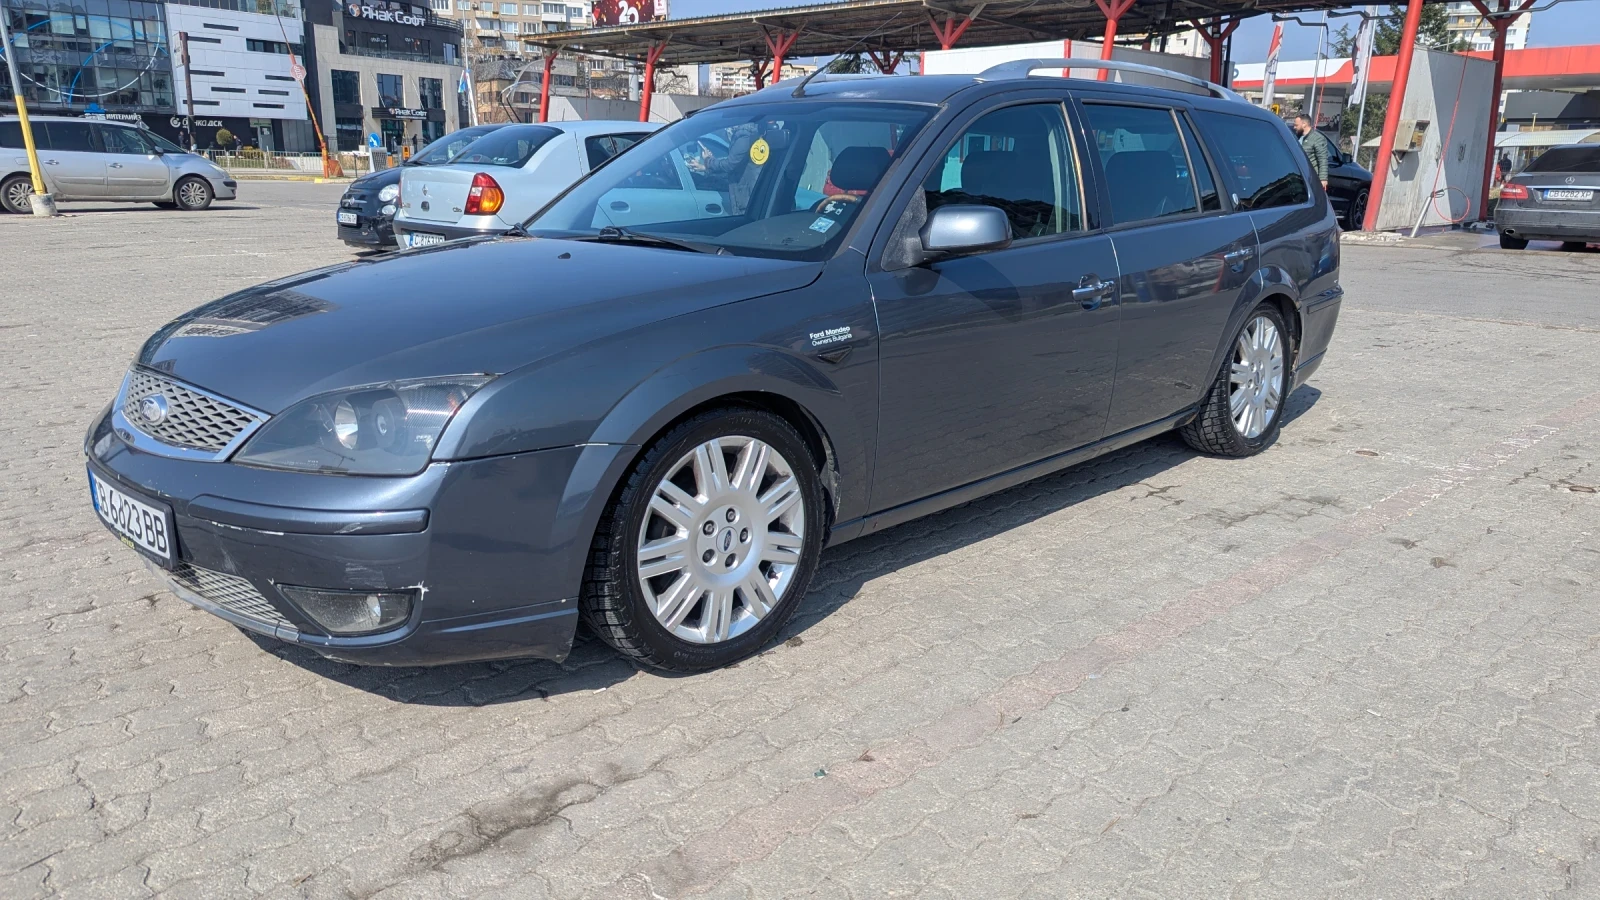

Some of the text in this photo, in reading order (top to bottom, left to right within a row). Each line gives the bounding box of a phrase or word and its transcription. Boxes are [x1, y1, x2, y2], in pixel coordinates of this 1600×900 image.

[361, 6, 426, 27] Янак Софт
[809, 326, 851, 340] Ford Mondeo
[812, 333, 853, 346] Owners Bulgaria
[142, 508, 167, 553] BB
